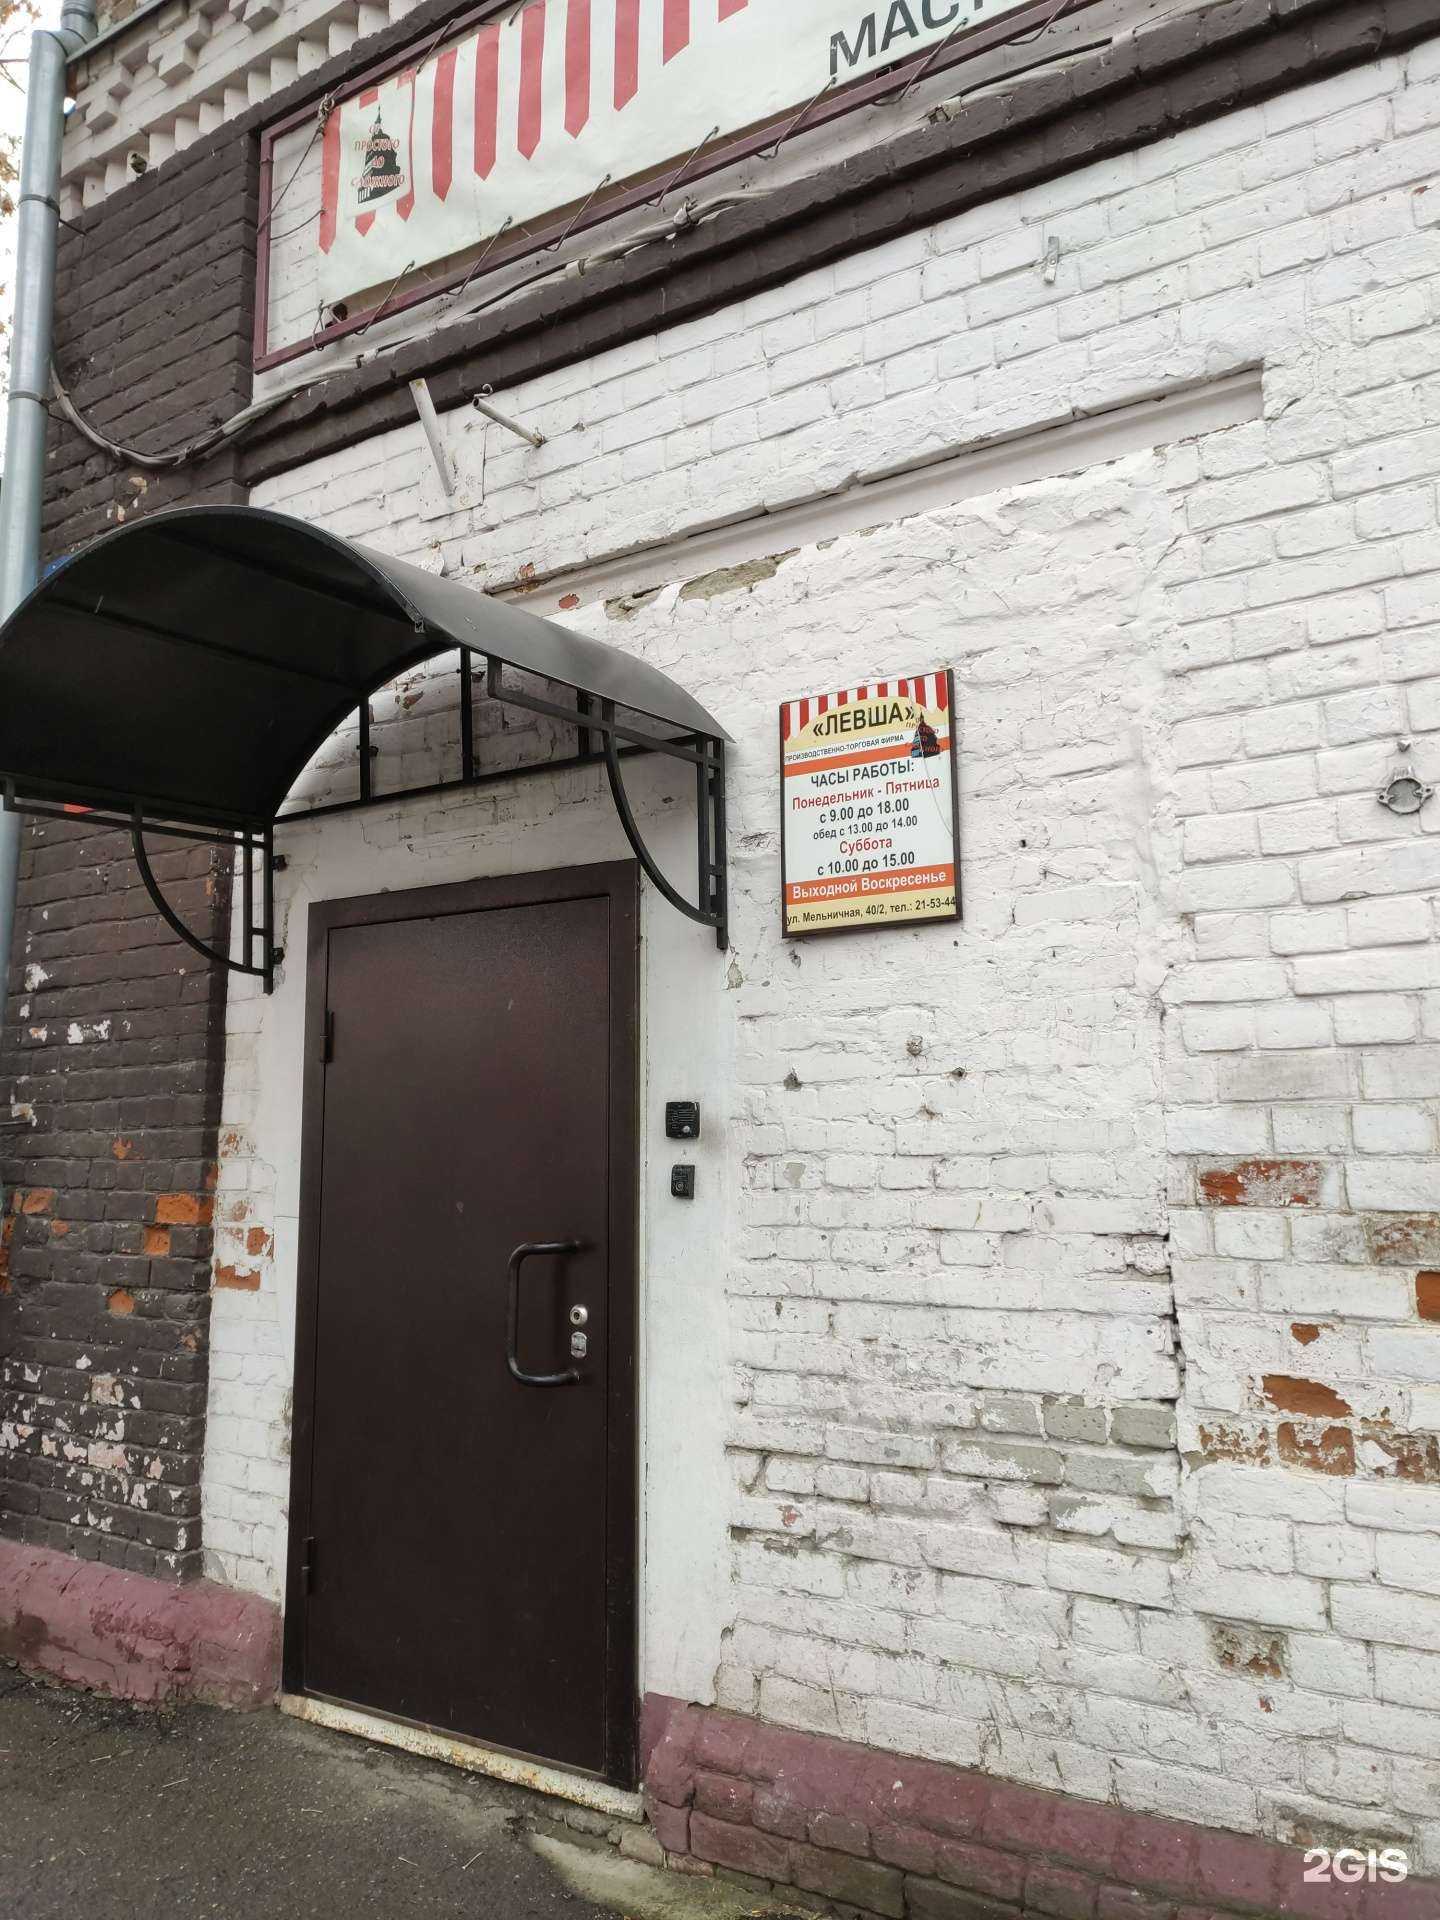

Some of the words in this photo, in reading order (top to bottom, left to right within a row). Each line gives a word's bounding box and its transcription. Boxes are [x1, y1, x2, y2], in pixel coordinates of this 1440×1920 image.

[829, 0, 984, 76] МАС
[813, 702, 915, 737] «ЛЕВША»
[880, 734, 904, 744] ФИРМА
[811, 770, 849, 788] ЧАСЫ
[853, 760, 915, 781] РАБОТЫ:
[792, 788, 874, 811] Понедельник
[885, 778, 940, 795] Пятница
[820, 813, 827, 824] с
[829, 806, 854, 822] 9.00
[857, 806, 873, 819] до
[877, 798, 909, 815] 18.00
[813, 828, 837, 840] обед
[840, 828, 845, 836] с
[848, 822, 873, 835] 13.00
[875, 822, 889, 832] до
[891, 815, 918, 828] 14.00
[839, 838, 893, 856] Суббота
[817, 865, 824, 876] с
[827, 859, 859, 875] 10.00
[862, 859, 879, 872] до
[882, 851, 915, 868] 15.00
[792, 876, 858, 899] Выходной
[861, 871, 947, 891] Воскресенье
[786, 916, 800, 926] ул.
[803, 907, 863, 923] Мельничная,
[865, 903, 888, 916] 40/2,
[890, 902, 913, 913] тел.:
[915, 895, 956, 911] 21-53-44
